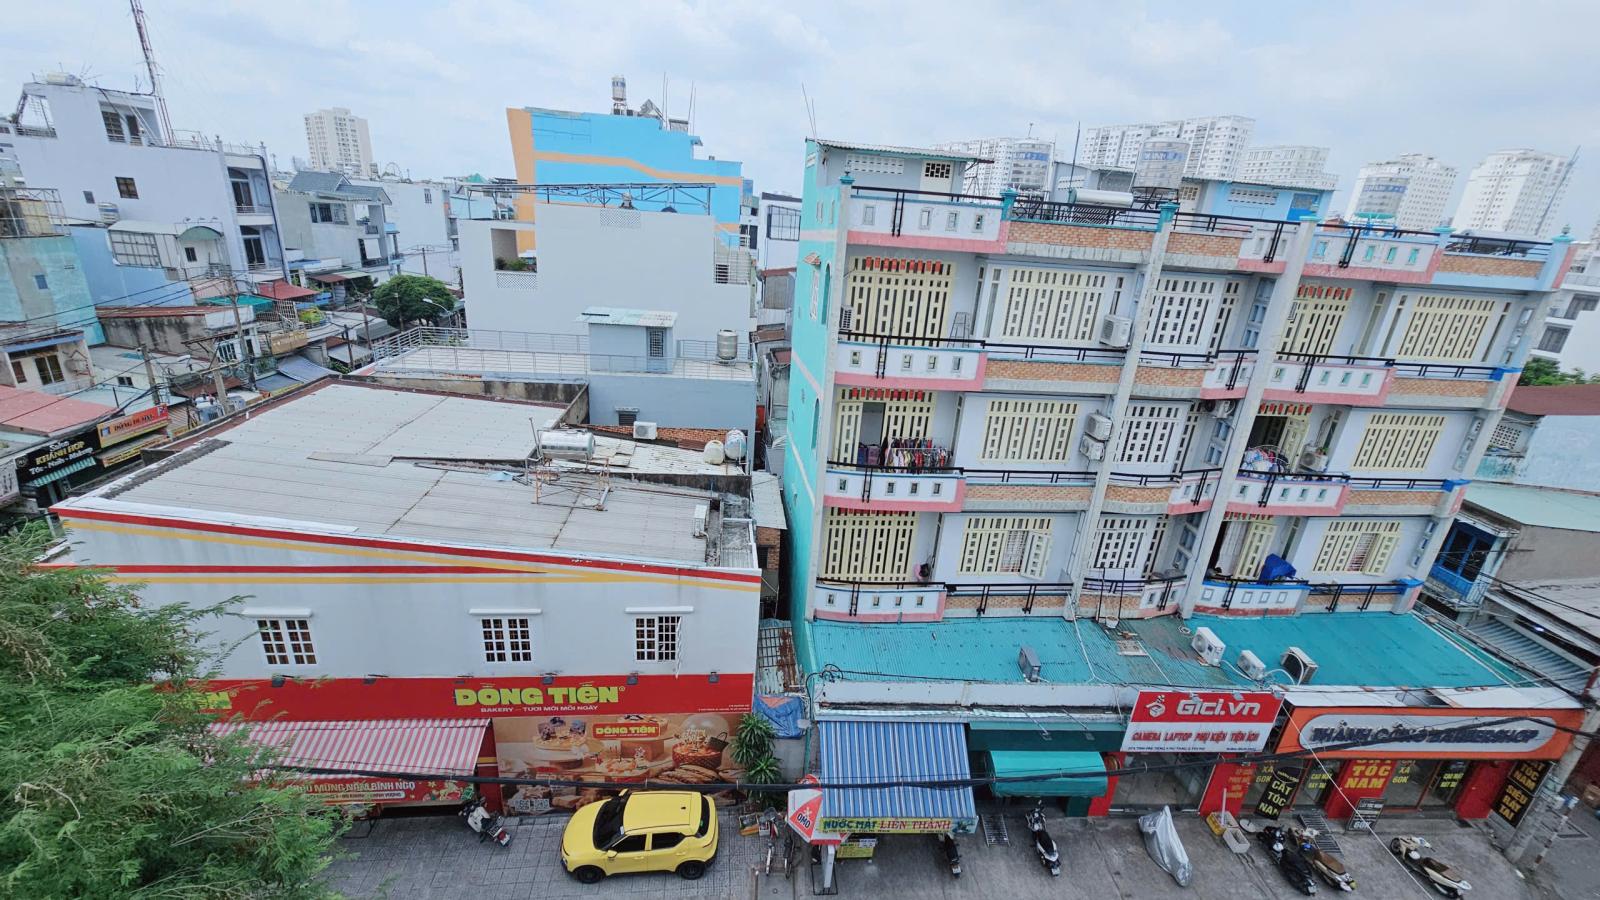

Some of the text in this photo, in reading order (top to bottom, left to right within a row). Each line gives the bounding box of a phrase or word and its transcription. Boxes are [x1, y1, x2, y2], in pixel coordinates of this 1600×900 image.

[453, 681, 619, 706] ĐỒNG TIỀN
[1176, 698, 1261, 717] Gici.vn
[1353, 762, 1391, 776] TÓC
[1344, 778, 1386, 788] NAM
[1513, 770, 1536, 790] NAM
[1267, 791, 1287, 807] TÓC
[797, 813, 811, 829] OMO
[879, 818, 907, 829] LIÊN
